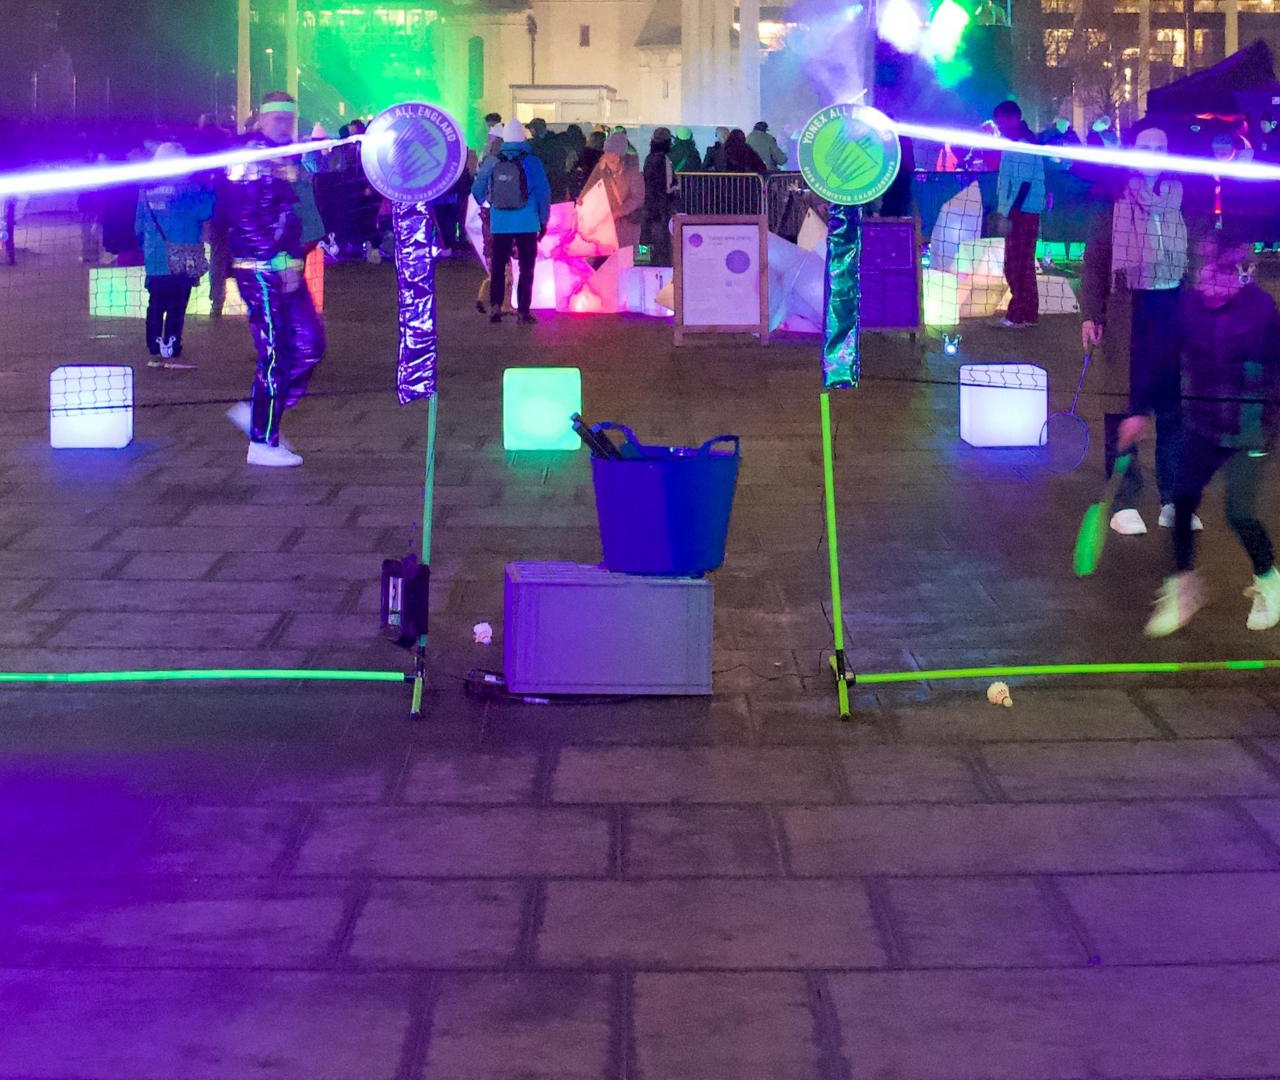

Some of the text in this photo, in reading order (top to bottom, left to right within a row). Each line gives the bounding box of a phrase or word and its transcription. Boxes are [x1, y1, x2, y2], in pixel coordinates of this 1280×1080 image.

[395, 105, 414, 117] ALL
[418, 106, 457, 142] ENGLAND
[802, 113, 828, 144] YONEX
[830, 106, 849, 119] ALL
